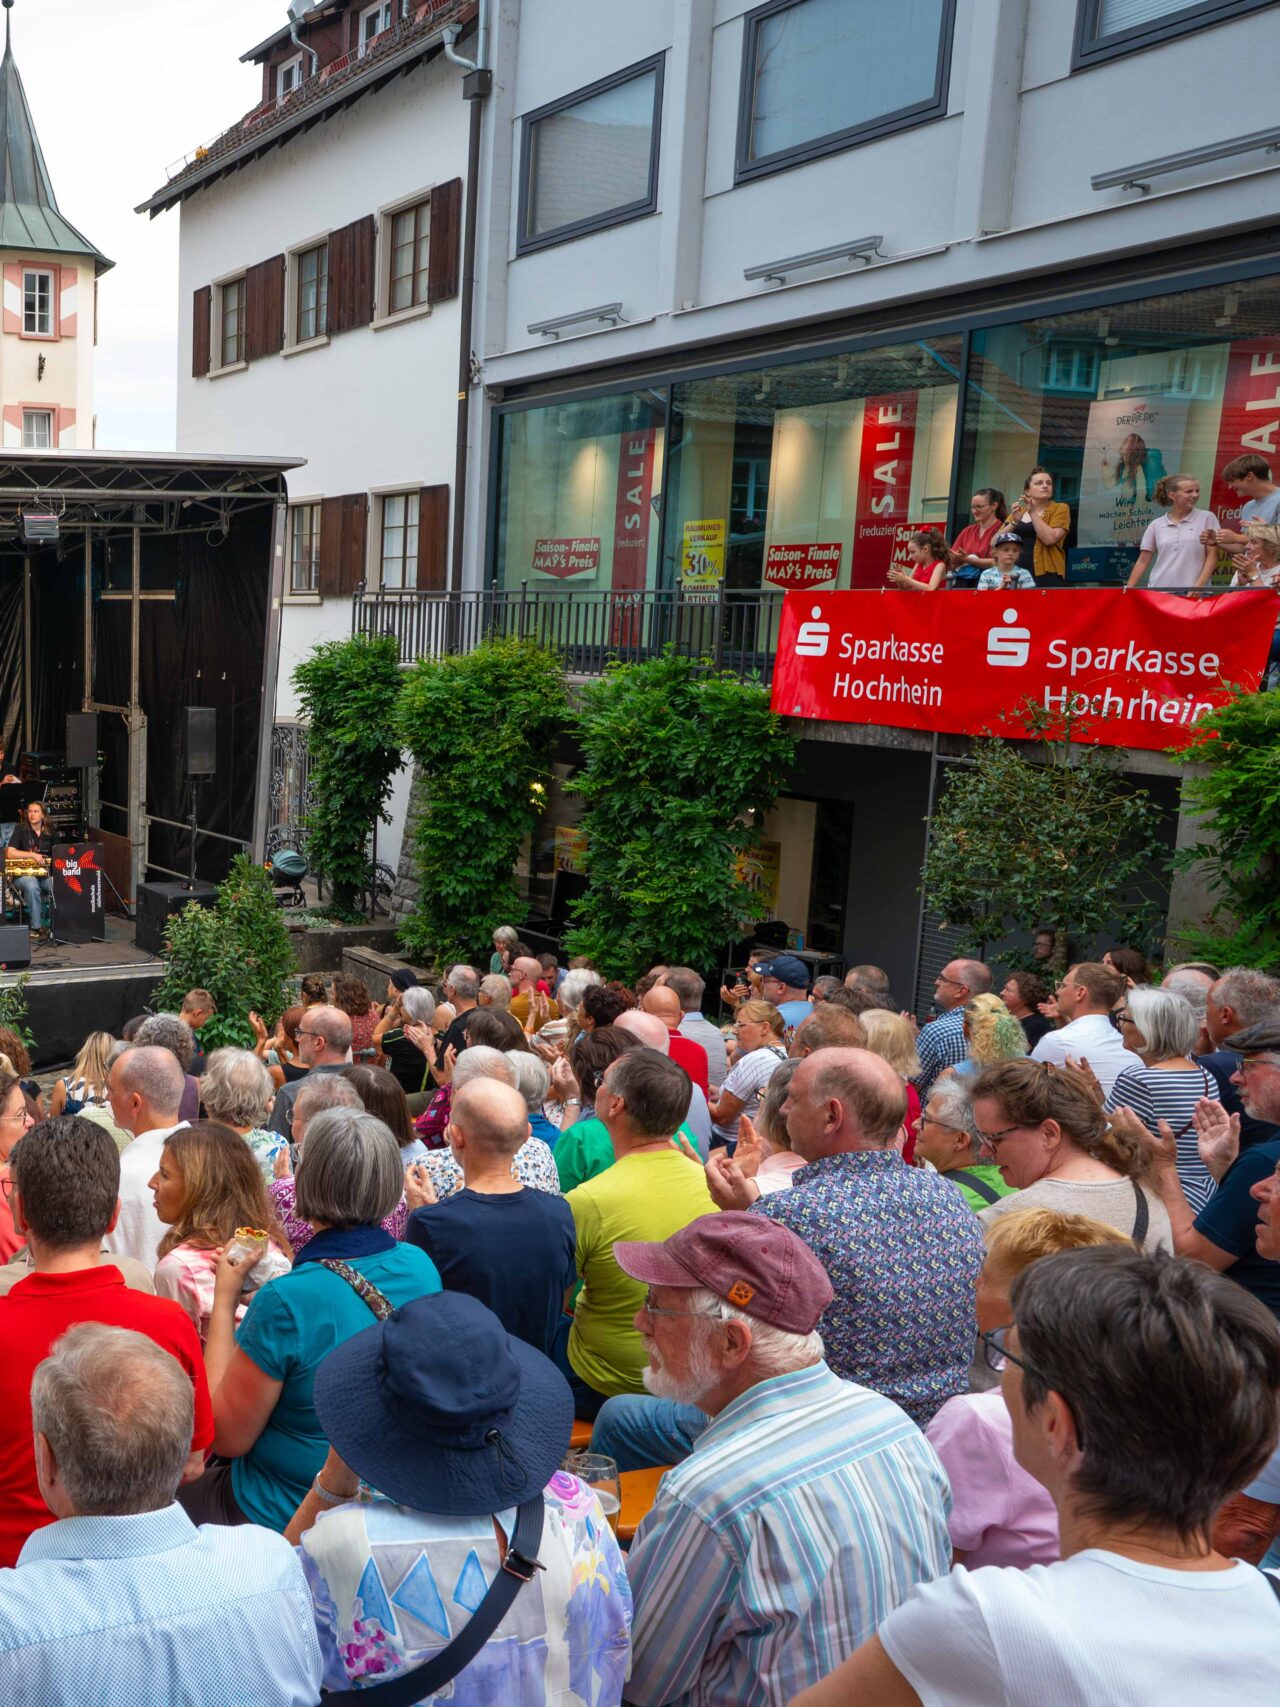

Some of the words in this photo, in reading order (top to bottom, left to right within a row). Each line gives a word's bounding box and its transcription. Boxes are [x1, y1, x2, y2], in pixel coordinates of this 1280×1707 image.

[1241, 352, 1280, 455] ALE
[872, 402, 902, 514] SALE
[625, 439, 646, 529] SALE
[690, 534, 718, 542] VERKAUF
[860, 524, 896, 538] [reduzier
[536, 542, 568, 553] Saison-
[571, 540, 599, 552] Finale
[768, 546, 804, 561] Saison-
[808, 545, 840, 560] Finale
[569, 554, 594, 568] Preis
[684, 550, 720, 577] 30%
[804, 564, 832, 580] Preis
[838, 633, 944, 664] Sparkasse
[1046, 639, 1220, 678] Sparkasse
[833, 672, 942, 706] Hochrhein
[1044, 685, 1214, 725] Hochrhein
[62, 867, 81, 876] band
[66, 860, 78, 869] big
